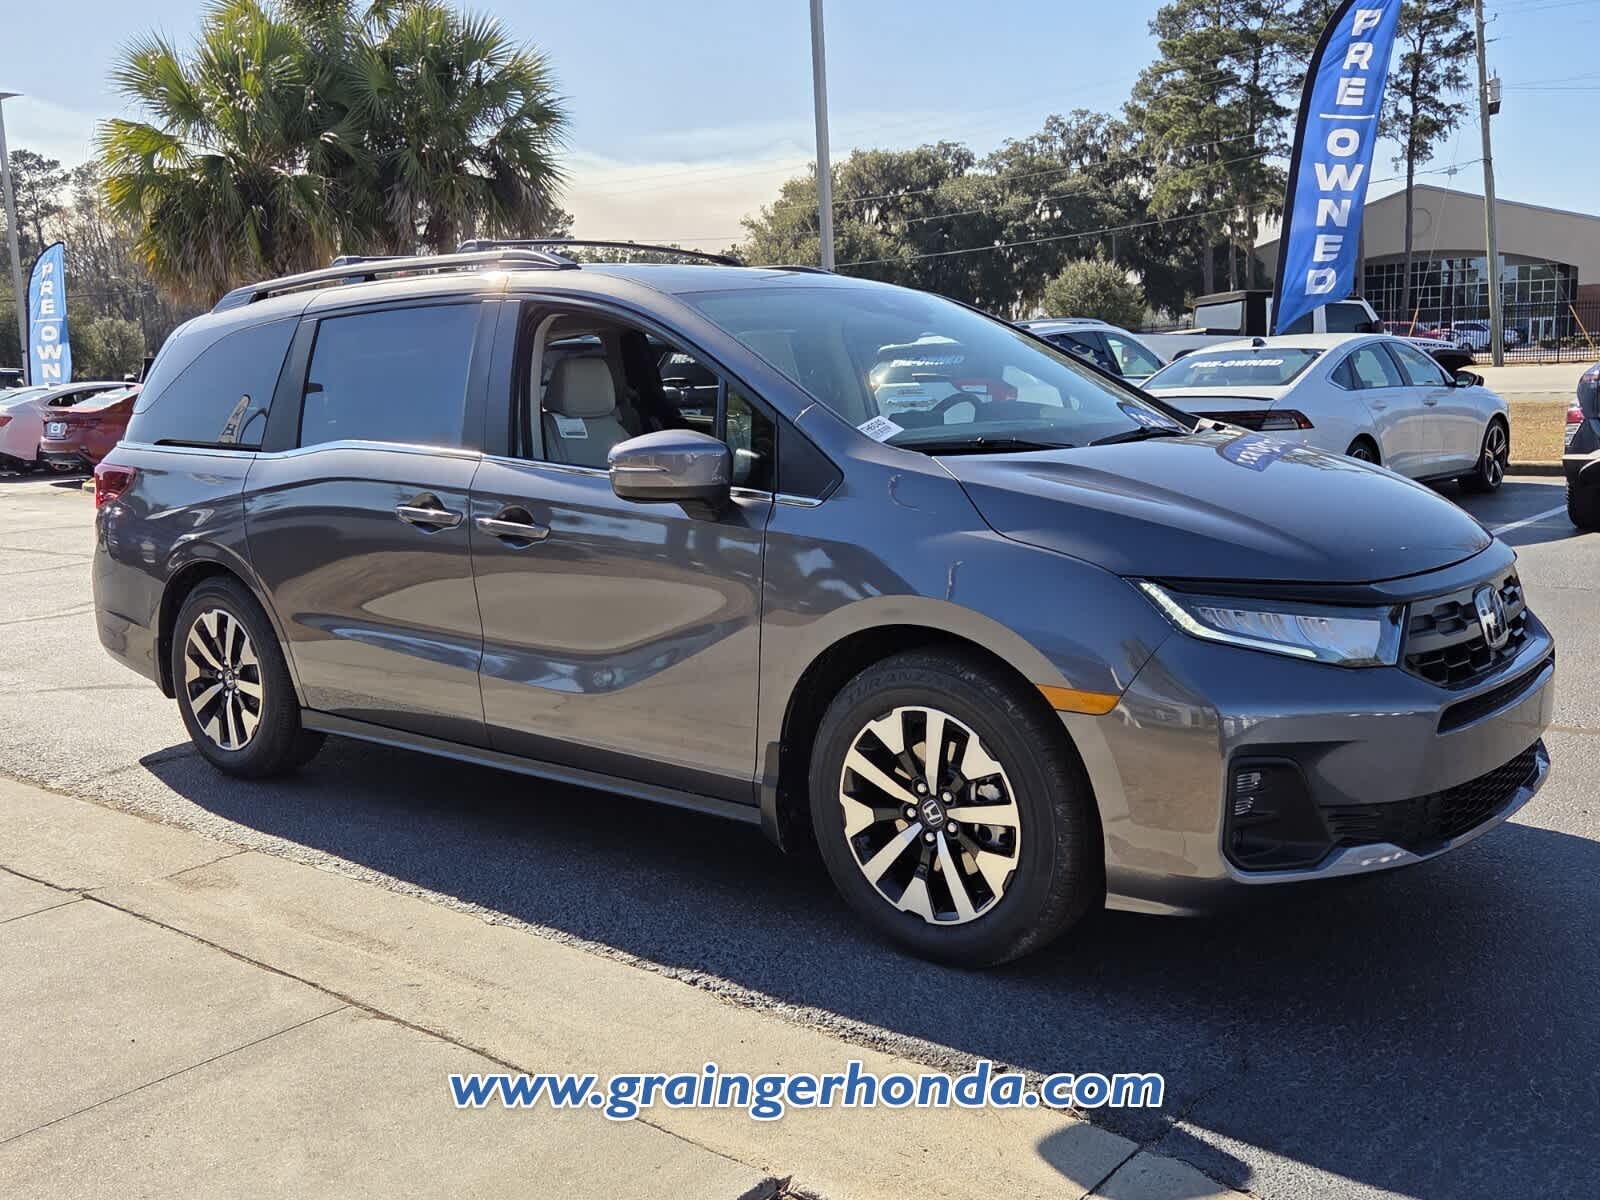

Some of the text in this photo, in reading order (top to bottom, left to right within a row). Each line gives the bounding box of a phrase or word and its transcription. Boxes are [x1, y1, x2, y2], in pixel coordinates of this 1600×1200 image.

[1305, 8, 1383, 296] PRE OWNED
[36, 262, 63, 385] PRE OWN
